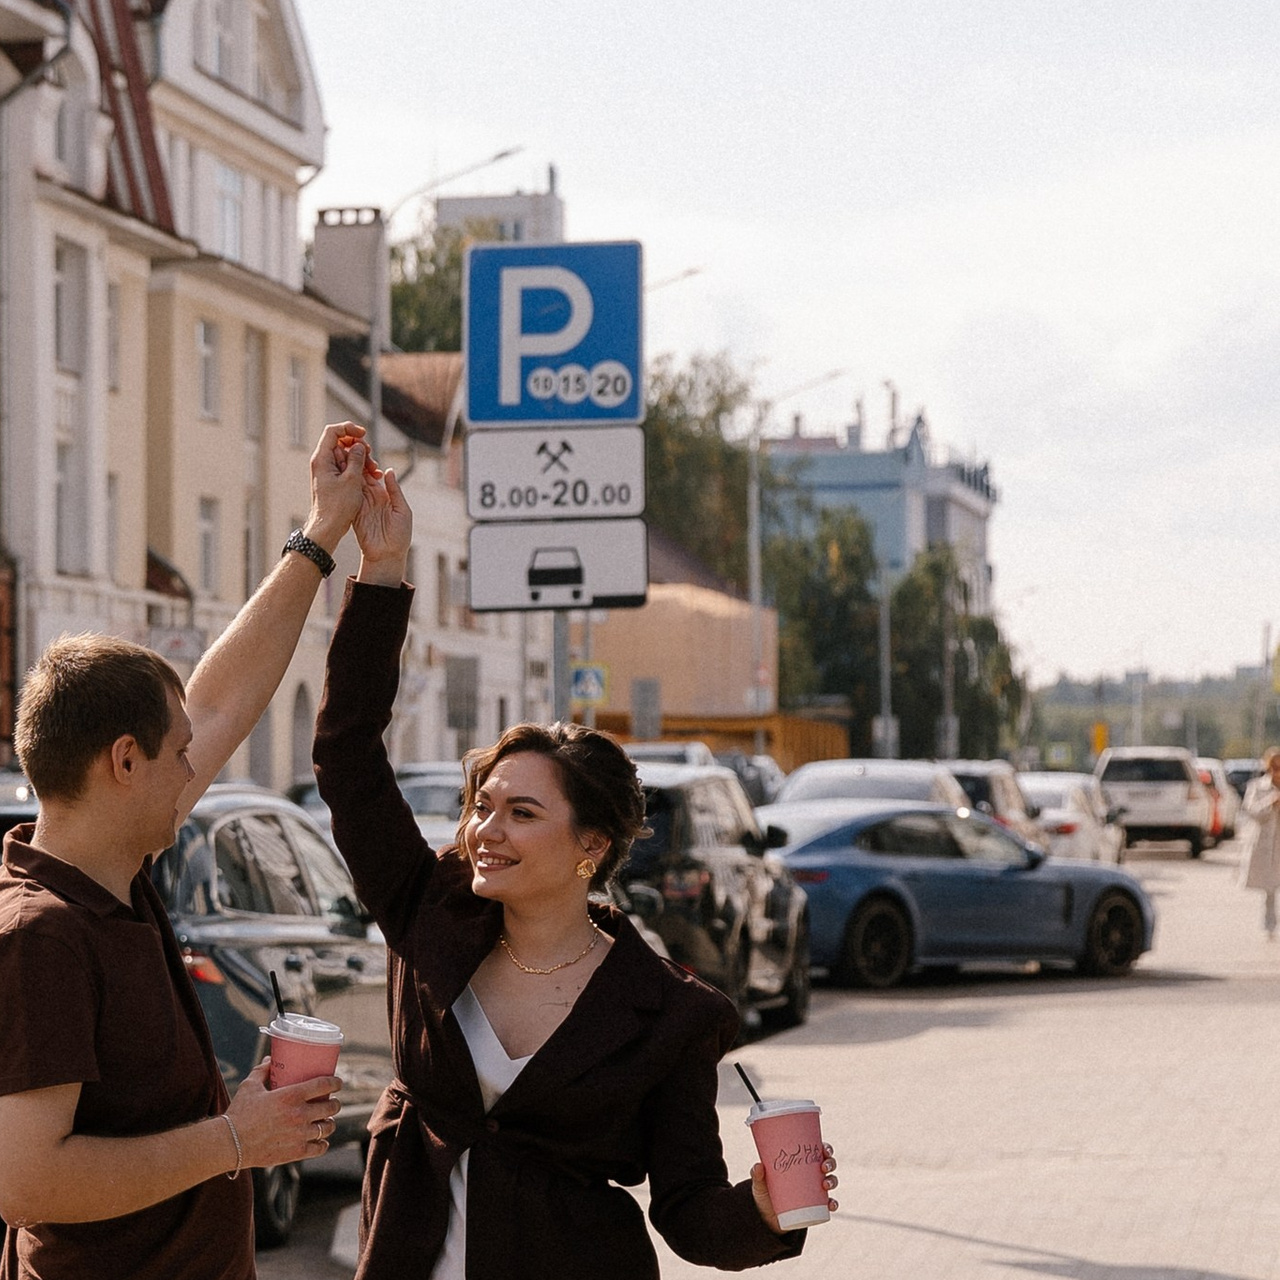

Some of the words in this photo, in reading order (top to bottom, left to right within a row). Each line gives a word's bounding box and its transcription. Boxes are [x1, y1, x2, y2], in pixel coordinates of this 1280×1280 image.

[498, 265, 594, 407] P
[533, 374, 553, 391] 10
[562, 374, 587, 395] 15
[596, 373, 627, 397] 20
